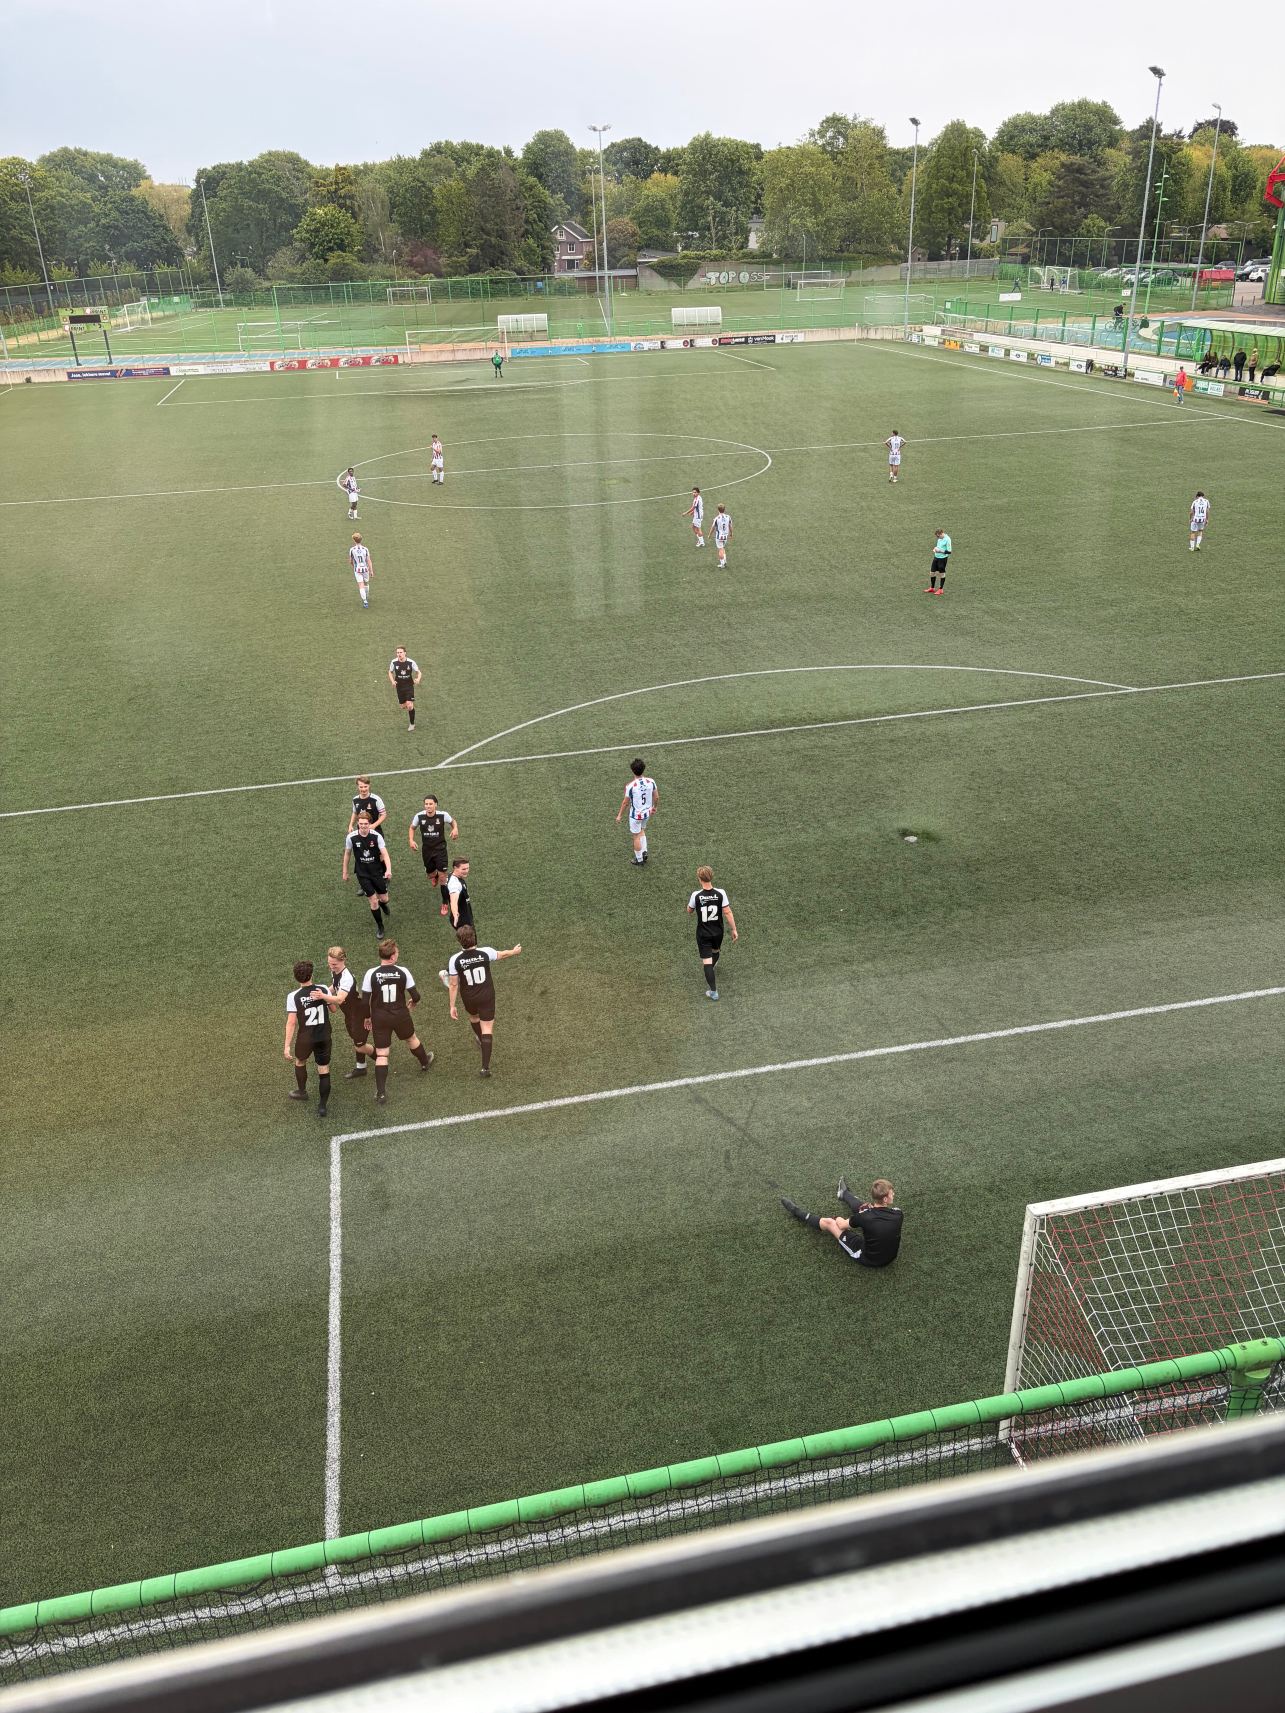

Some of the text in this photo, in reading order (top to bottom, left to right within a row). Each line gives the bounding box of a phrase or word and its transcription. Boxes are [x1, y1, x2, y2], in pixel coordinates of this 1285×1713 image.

[641, 792, 647, 806] 5
[700, 904, 719, 923] 12
[463, 966, 486, 986] 10
[380, 983, 397, 1003] 11
[304, 1004, 325, 1026] 21
